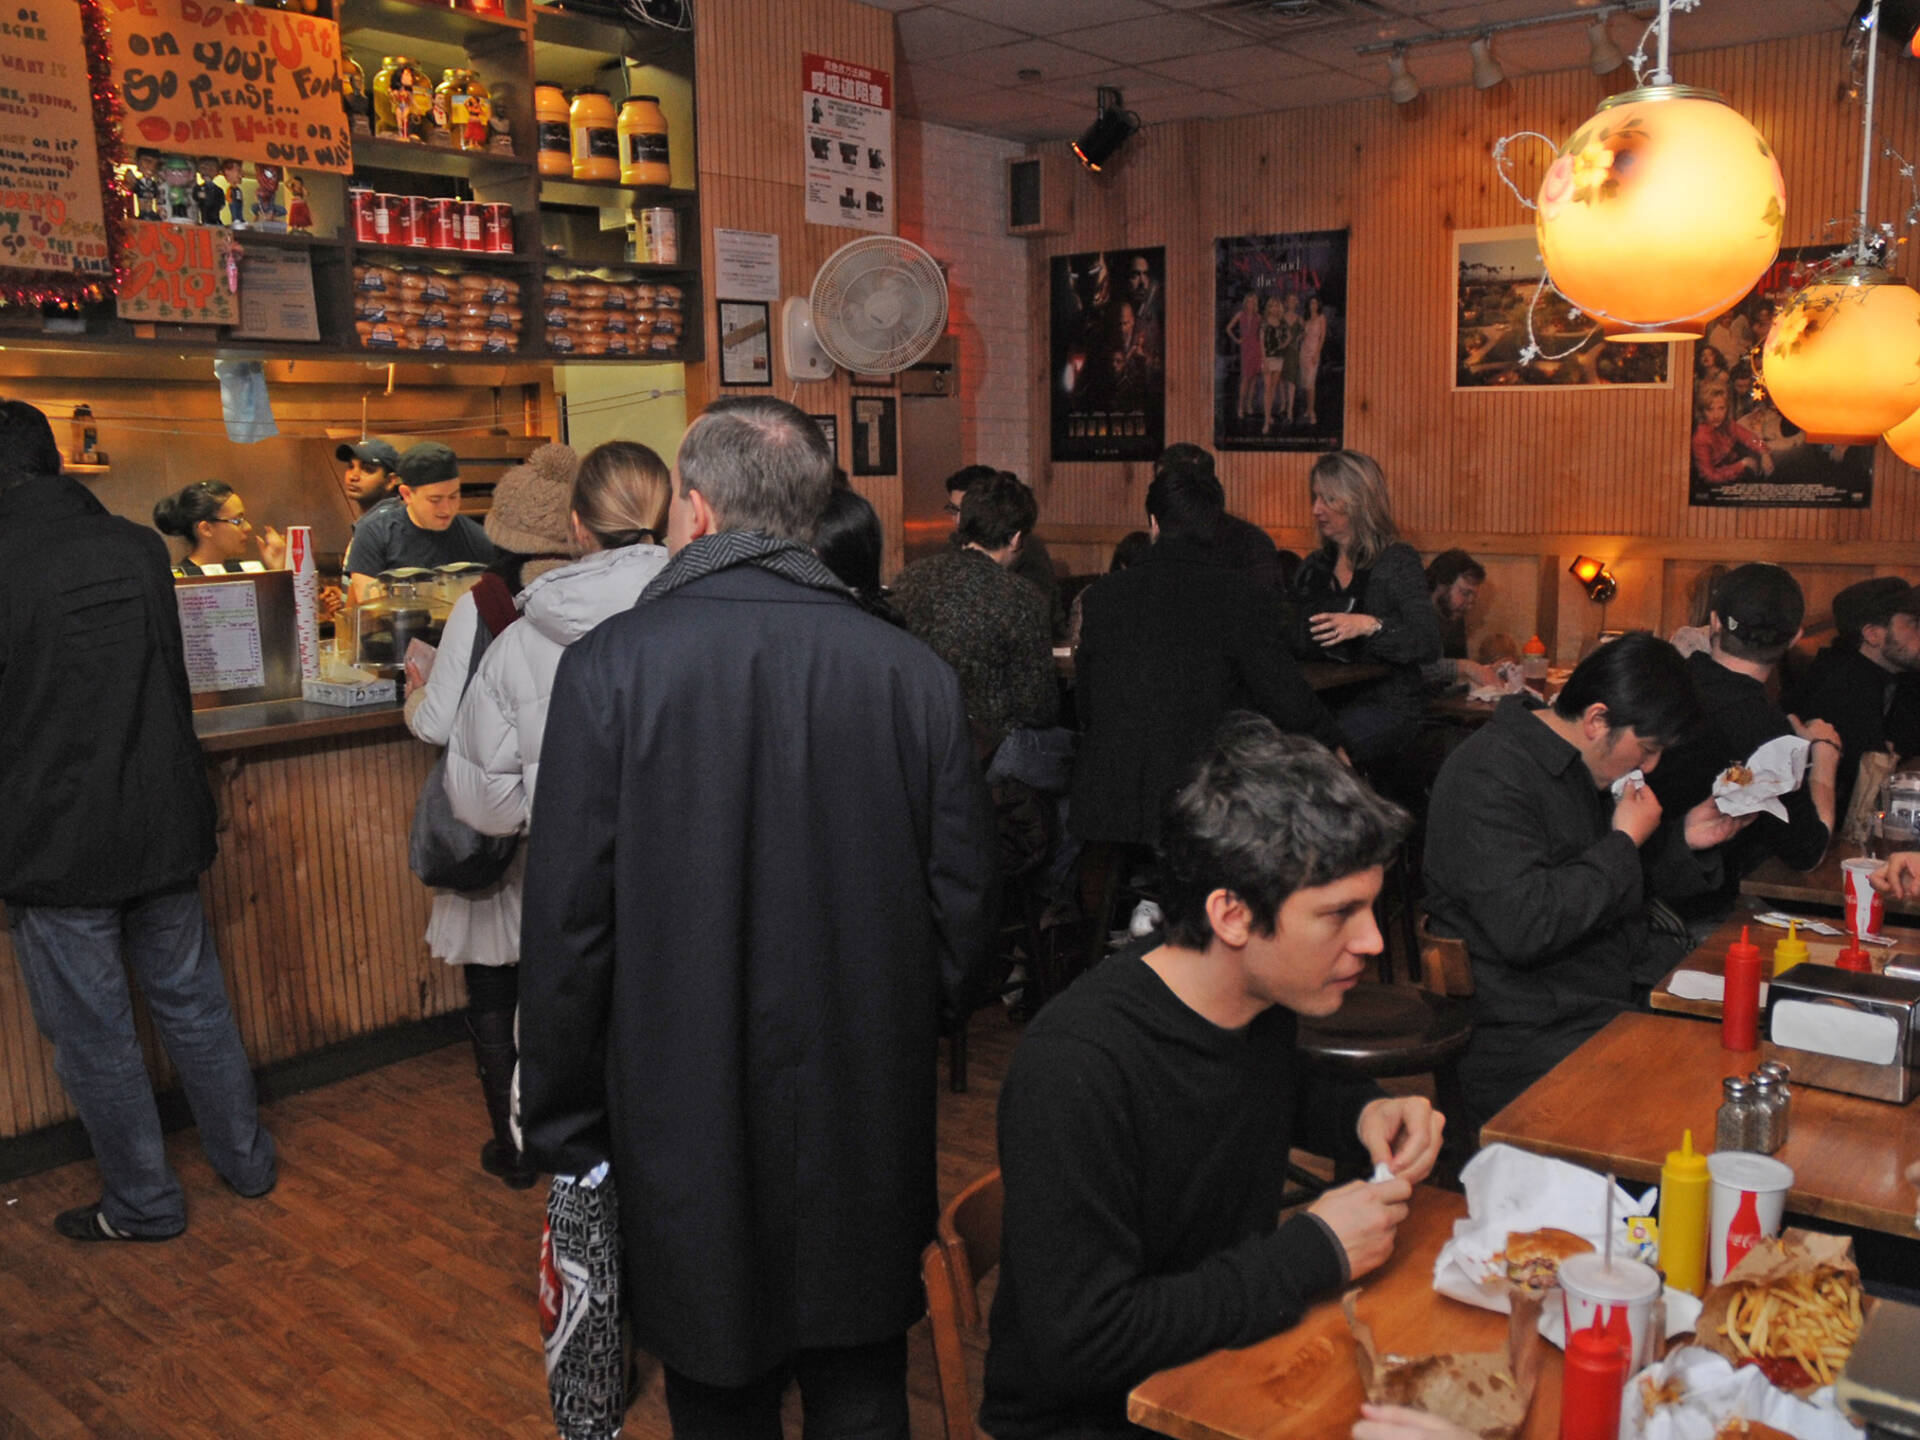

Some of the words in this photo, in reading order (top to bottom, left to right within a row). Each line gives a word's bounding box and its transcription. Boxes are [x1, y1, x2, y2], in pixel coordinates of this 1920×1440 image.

[1, 54, 46, 74] WANT
[128, 31, 180, 56] on
[292, 58, 343, 100] Food
[122, 68, 179, 112] So
[137, 110, 224, 143] Don't
[306, 123, 333, 141] on
